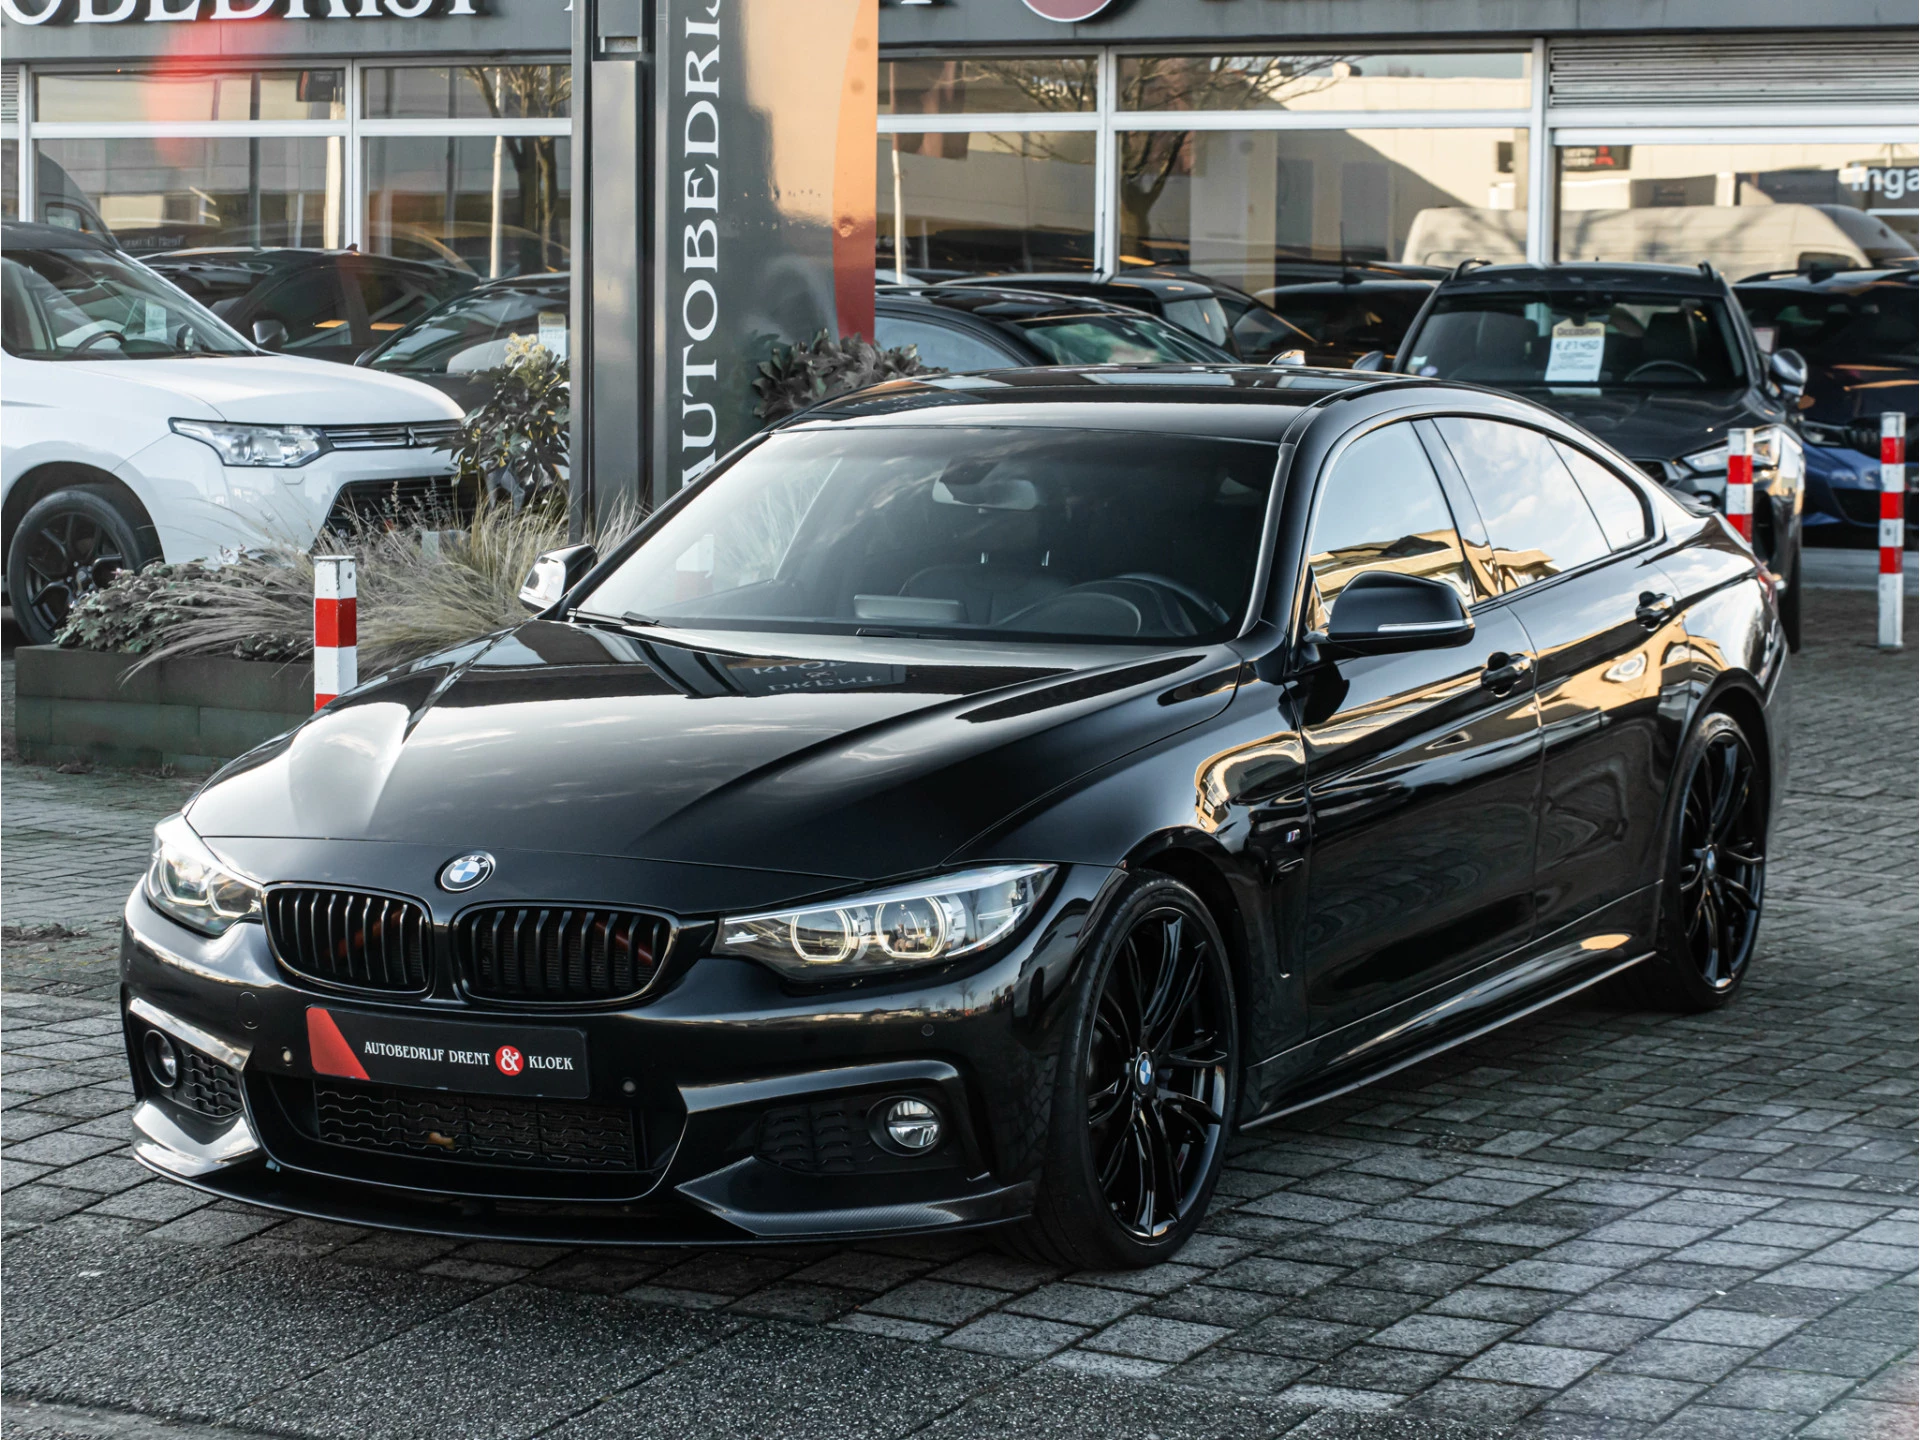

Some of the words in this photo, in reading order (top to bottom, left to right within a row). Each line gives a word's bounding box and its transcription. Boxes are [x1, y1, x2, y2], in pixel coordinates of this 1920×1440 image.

[364, 1041, 445, 1063] AUTOBEDRIJF
[448, 1049, 490, 1066] DRENT
[500, 1048, 519, 1072] &
[528, 1055, 574, 1071] KLOEK
